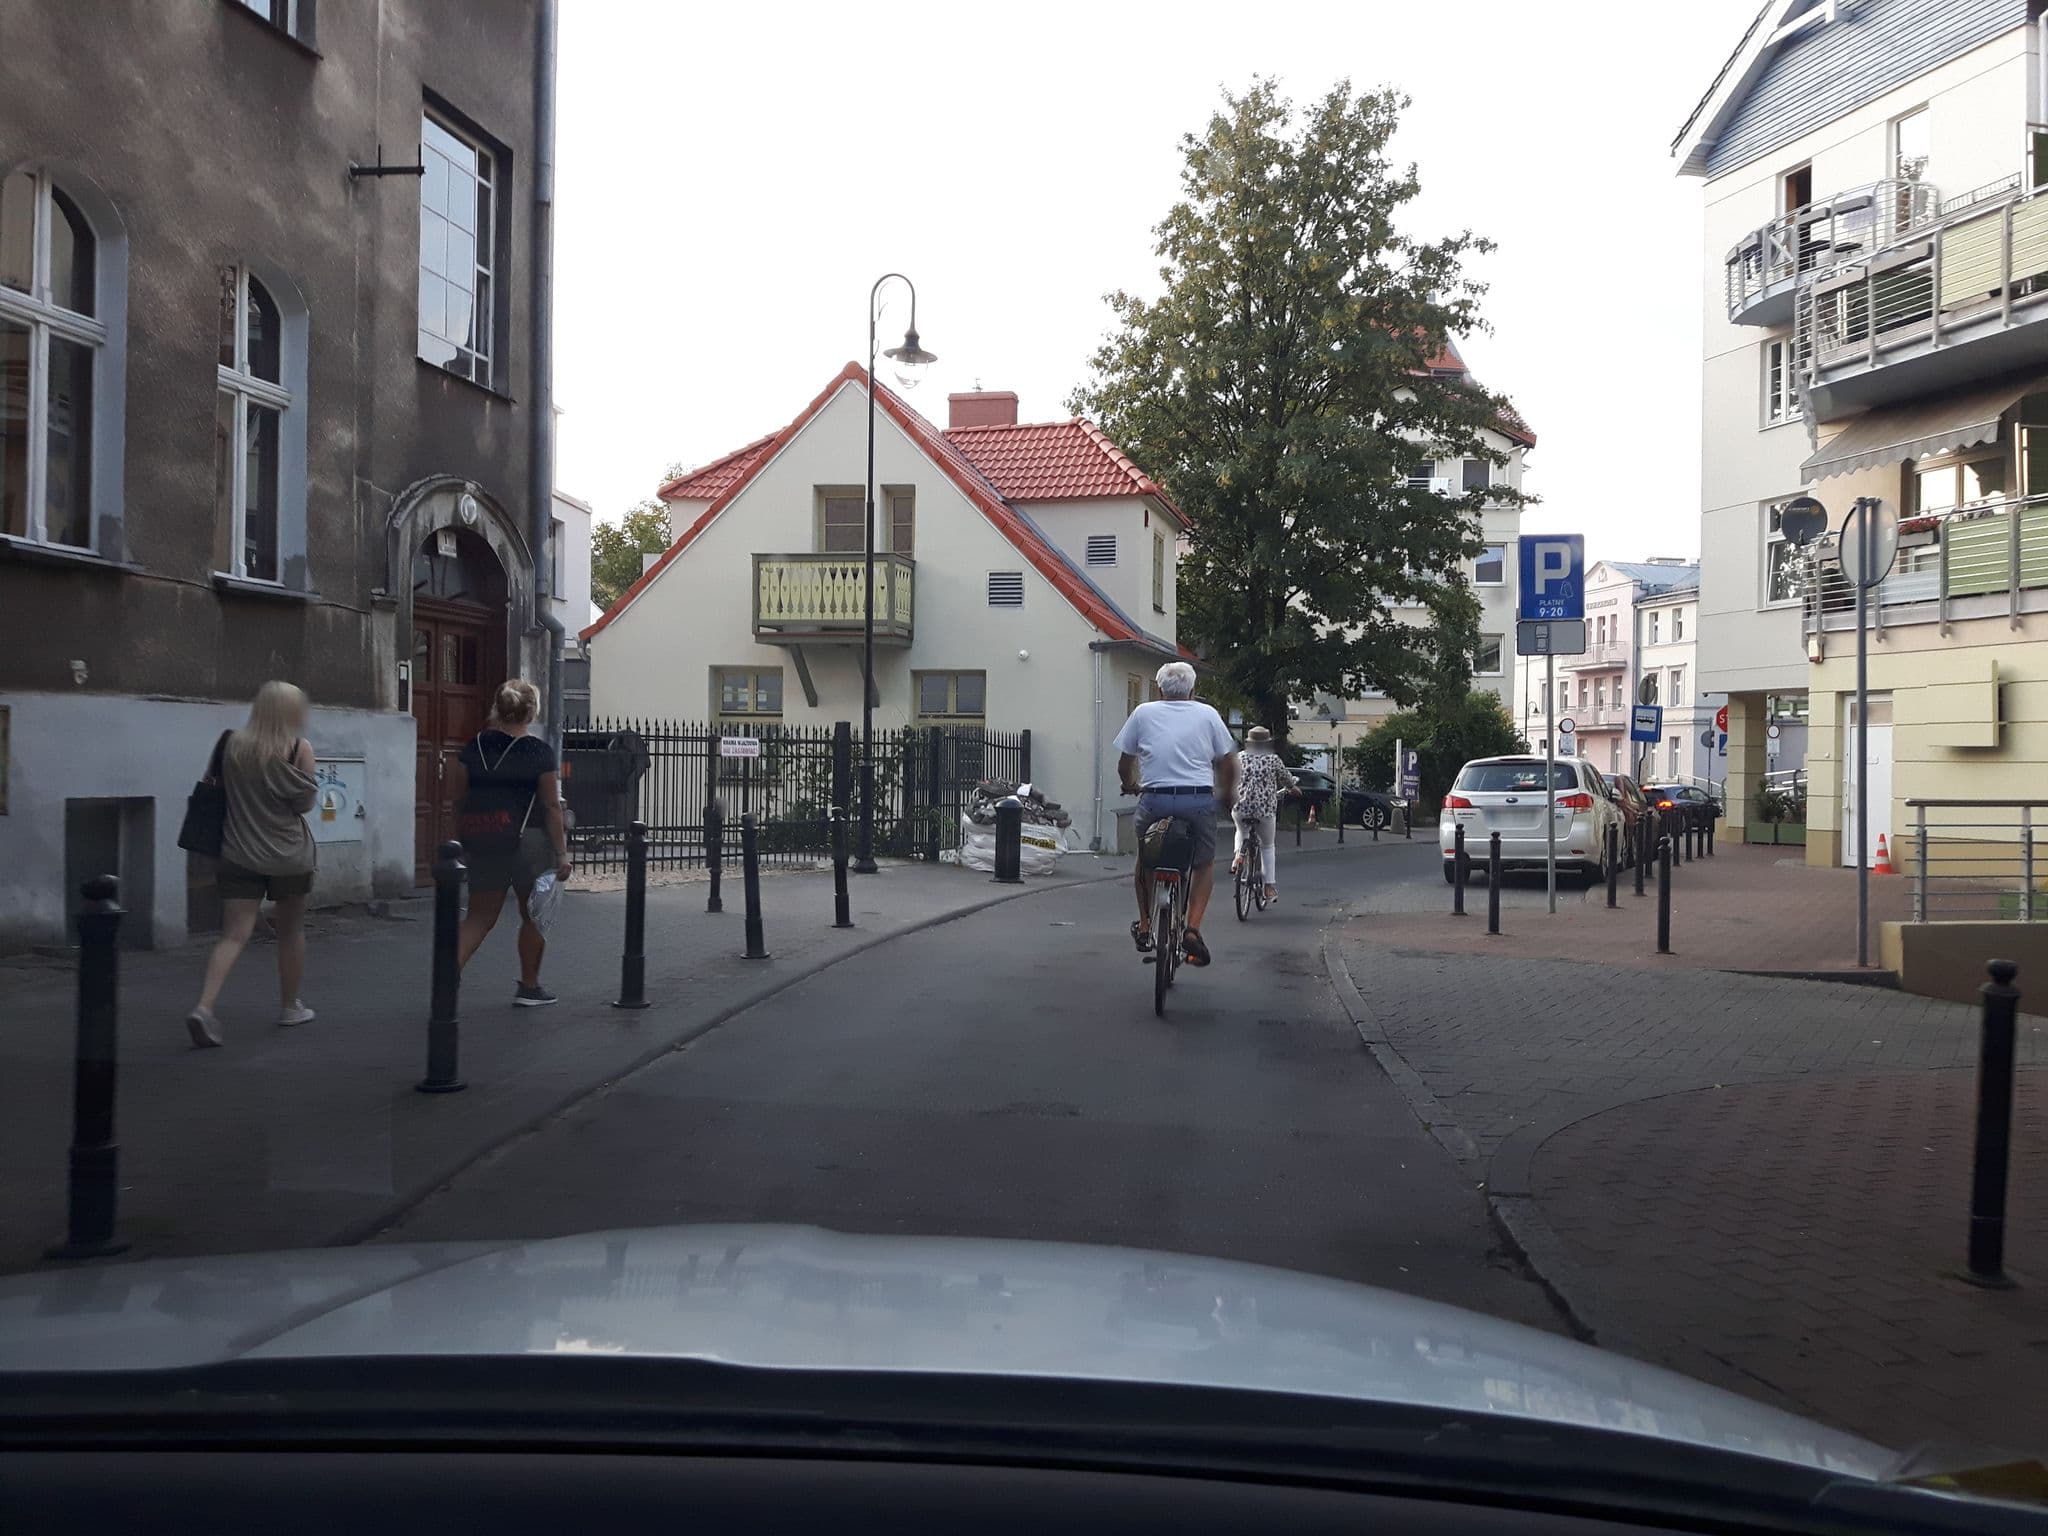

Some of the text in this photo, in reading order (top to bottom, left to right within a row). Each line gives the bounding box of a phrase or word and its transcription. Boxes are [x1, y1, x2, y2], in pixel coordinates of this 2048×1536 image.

[1535, 542, 1571, 594] P
[1539, 607, 1563, 617] 9-20
[1408, 751, 1418, 770] P
